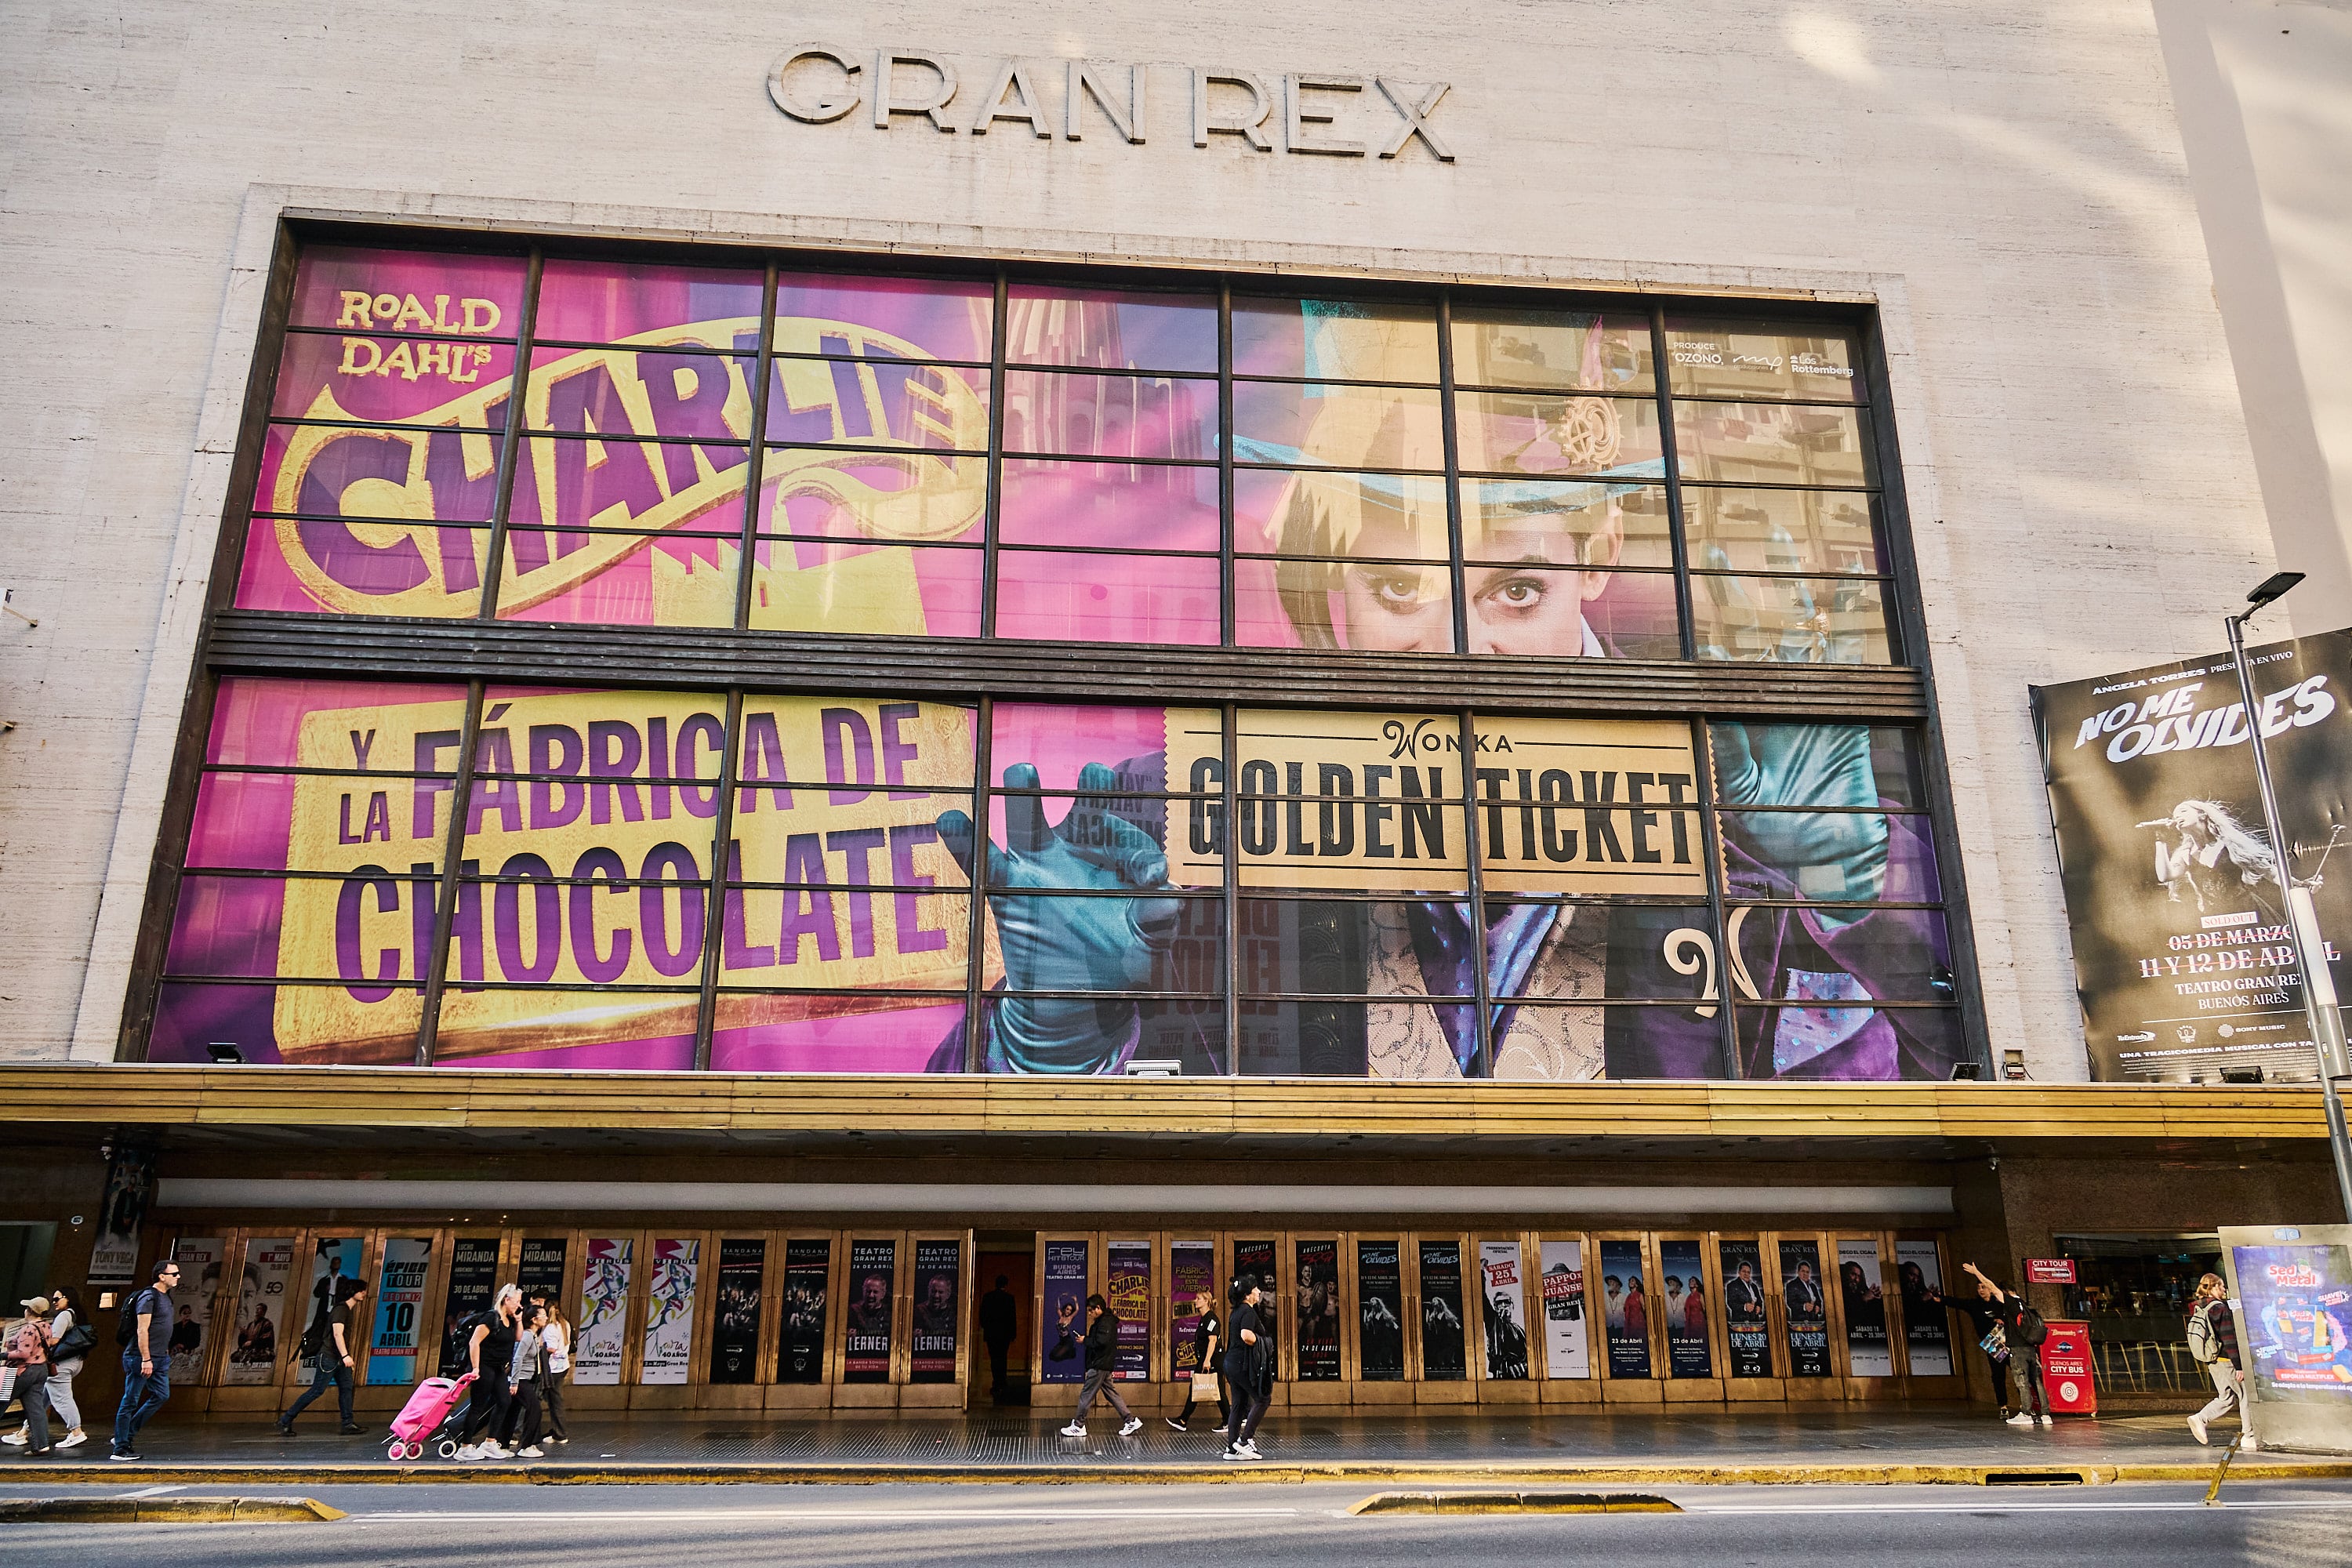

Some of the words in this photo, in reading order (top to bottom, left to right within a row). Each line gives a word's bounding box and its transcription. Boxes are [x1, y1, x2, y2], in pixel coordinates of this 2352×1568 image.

[767, 42, 1146, 144] GRAN
[1192, 66, 1456, 162] REX
[336, 290, 502, 335] ROALD
[1673, 342, 1715, 350] PRODUCE
[338, 337, 492, 383] DAHL'S
[1791, 365, 1854, 377] Rottemberg
[298, 330, 958, 597] CHARLIE
[2149, 667, 2207, 684] TORRES
[2210, 659, 2256, 673] PRESTA
[2256, 655, 2269, 665] EN
[2270, 651, 2293, 662] VIVO
[2074, 702, 2136, 750] NO
[2134, 682, 2203, 724] ME
[2106, 675, 2336, 764] OLVIDES
[820, 702, 931, 808] DE
[350, 728, 376, 771] Y
[412, 702, 795, 840] FÁBRICA
[338, 790, 390, 845] LA
[1187, 756, 1447, 861] GOLDEN
[1475, 767, 1693, 865] TICKET
[334, 823, 947, 1004] CHOCOLATE
[2204, 916, 2231, 927] SOLD
[2233, 914, 2254, 924] OUT
[2169, 935, 2193, 951] 05
[2194, 931, 2224, 949] DE
[2138, 957, 2161, 978] 11
[2164, 956, 2180, 975] Y
[2187, 953, 2213, 974] 12
[2216, 949, 2255, 971] DE
[2259, 941, 2341, 967] ABL
[2175, 978, 2232, 996] TEATRO
[2234, 975, 2275, 990] GRAN
[2198, 993, 2250, 1010] BUENOS
[2252, 991, 2289, 1006] AIRES
[2143, 1046, 2223, 1058] TRAGICOMEDIA
[2224, 1042, 2273, 1052] MUSICAL
[2274, 1040, 2297, 1049] CON
[95, 1251, 114, 1264] TONY
[179, 1253, 195, 1262] GRAN
[196, 1252, 208, 1262] REX
[274, 1252, 291, 1262] MAYO
[456, 1251, 495, 1262] MIRANDA
[524, 1250, 562, 1261] MIRANDA
[1366, 1254, 1397, 1264] OLVIDES
[1427, 1254, 1458, 1264] OLVIDES
[1495, 1269, 1510, 1279] 25
[2270, 1265, 2296, 1276] Sed
[389, 1275, 422, 1287] TOUR
[1109, 1276, 1150, 1294] CHARLIE
[1543, 1272, 1577, 1286] PAPPO
[2276, 1272, 2316, 1286] Metal
[454, 1285, 462, 1294] 30
[463, 1285, 470, 1294] DE
[471, 1285, 489, 1294] ABRIL
[522, 1284, 530, 1293] 30
[1544, 1283, 1583, 1297] JUANSE
[2318, 1291, 2339, 1301] SUAVE
[386, 1302, 414, 1332] 10
[1112, 1308, 1147, 1319] CHOCOLATE
[379, 1333, 412, 1346] ABRIL
[848, 1336, 887, 1351] LERNER
[914, 1336, 953, 1351] LERNER
